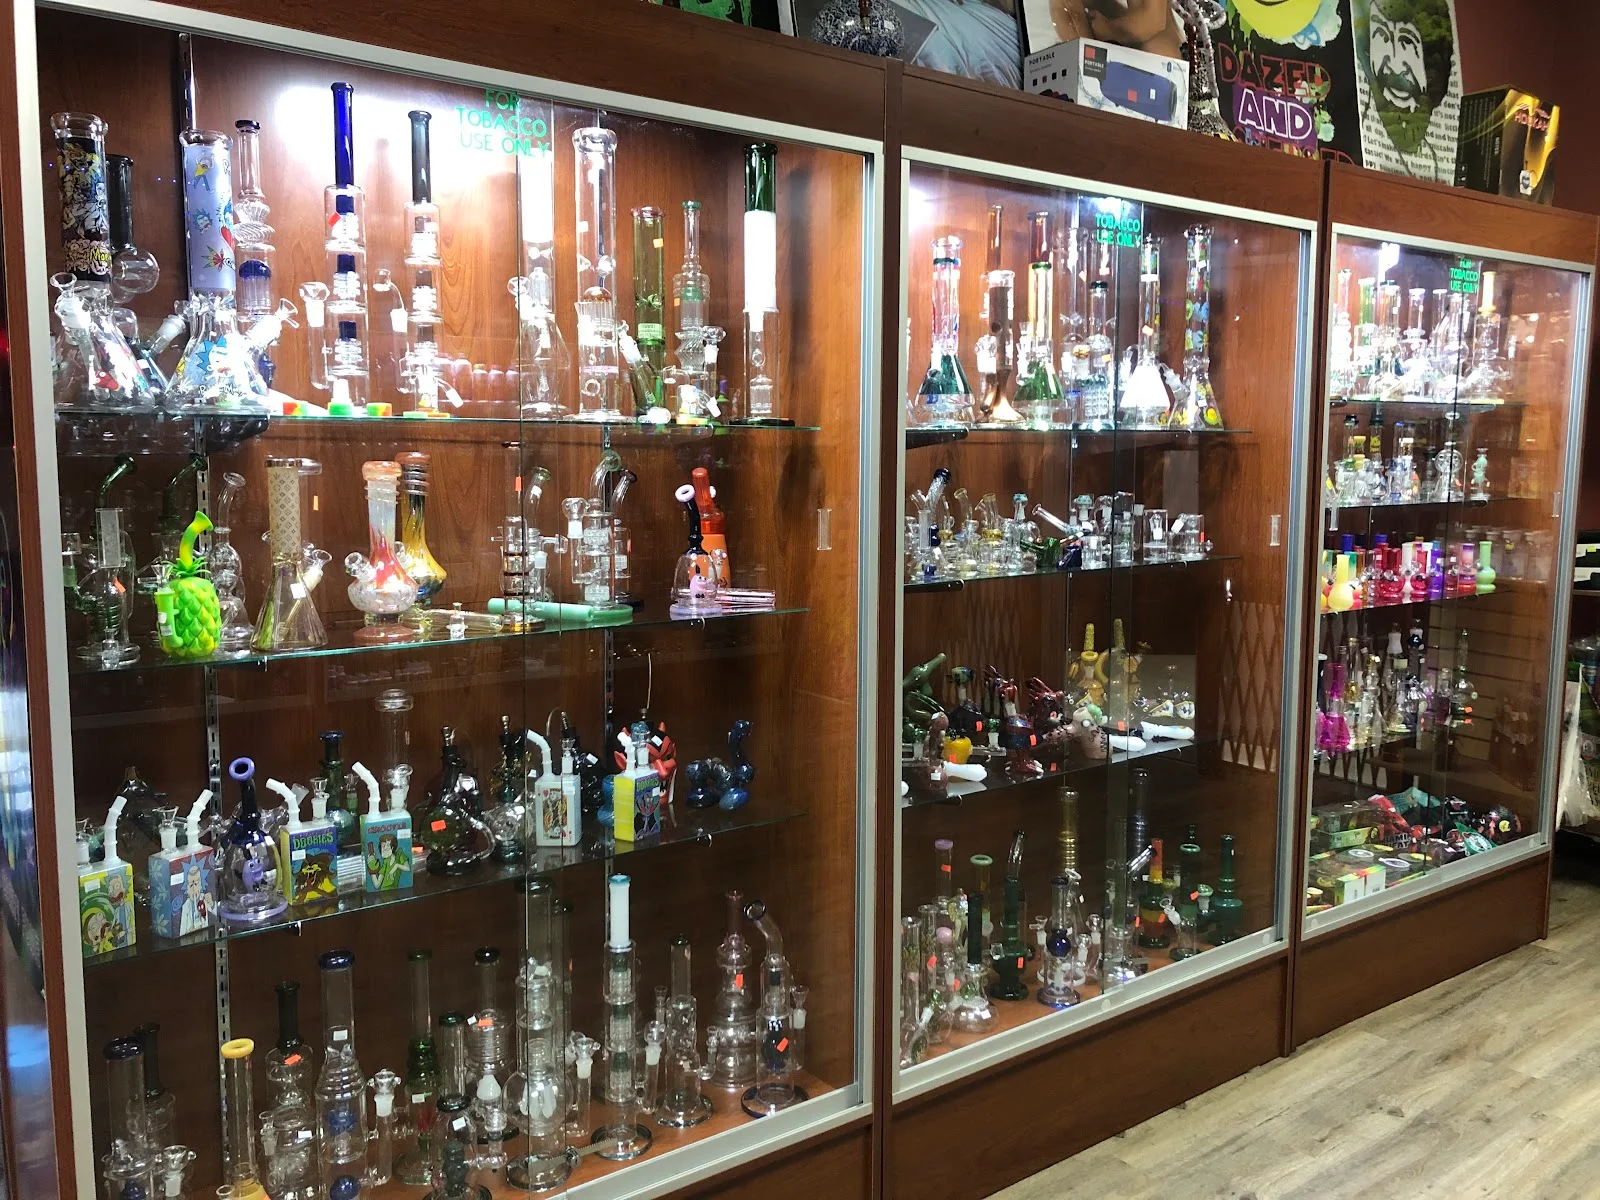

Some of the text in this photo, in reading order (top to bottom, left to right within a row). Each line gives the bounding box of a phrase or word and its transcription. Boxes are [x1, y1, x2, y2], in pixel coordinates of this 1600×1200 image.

[1029, 51, 1055, 66] PORTABLE
[1084, 59, 1104, 69] PORTABLE
[1217, 42, 1331, 99] DAZED
[485, 89, 520, 111] FOR
[456, 107, 548, 138] TOBACCO
[1238, 87, 1313, 140] AND
[460, 132, 551, 158] USE ONLY
[1096, 213, 1141, 233] TOBACCO
[1116, 231, 1142, 248] ONLY
[1459, 258, 1472, 269] FOR
[1450, 268, 1478, 281] TOBACCO
[1450, 280, 1479, 293] USE ONLY
